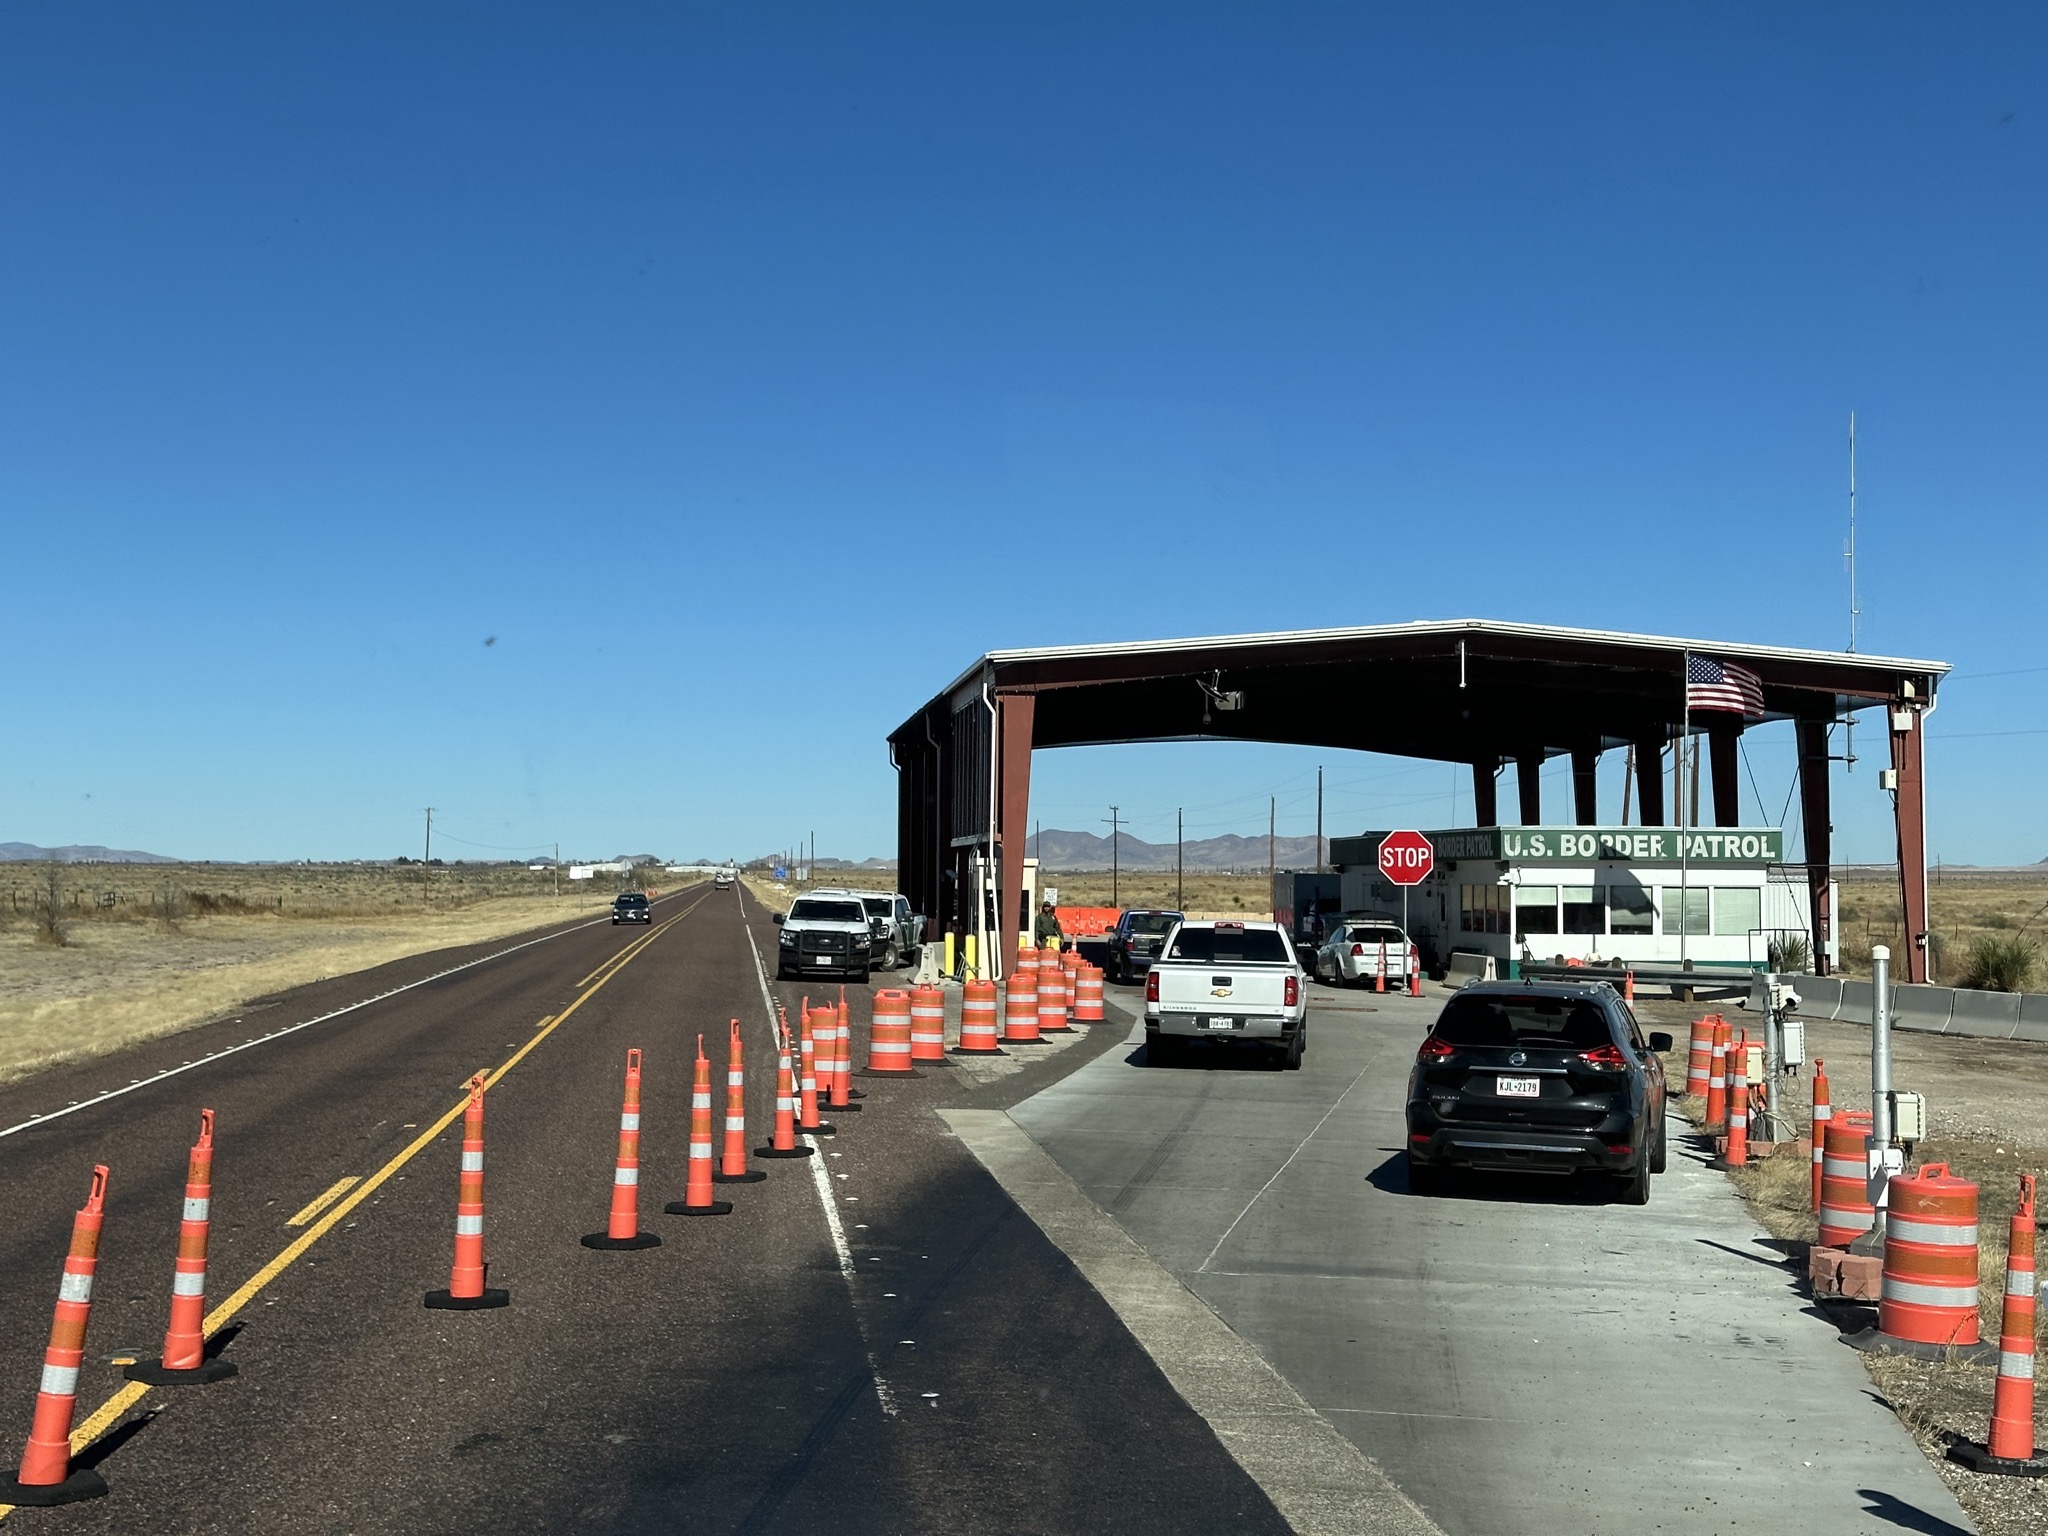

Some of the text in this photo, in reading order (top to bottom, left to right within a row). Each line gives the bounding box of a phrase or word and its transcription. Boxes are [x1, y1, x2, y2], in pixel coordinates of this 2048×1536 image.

[1382, 847, 1431, 868] STOP
[1437, 833, 1494, 858] BORDER PATROL
[1503, 834, 1776, 859] U.S. BORDER PATROL
